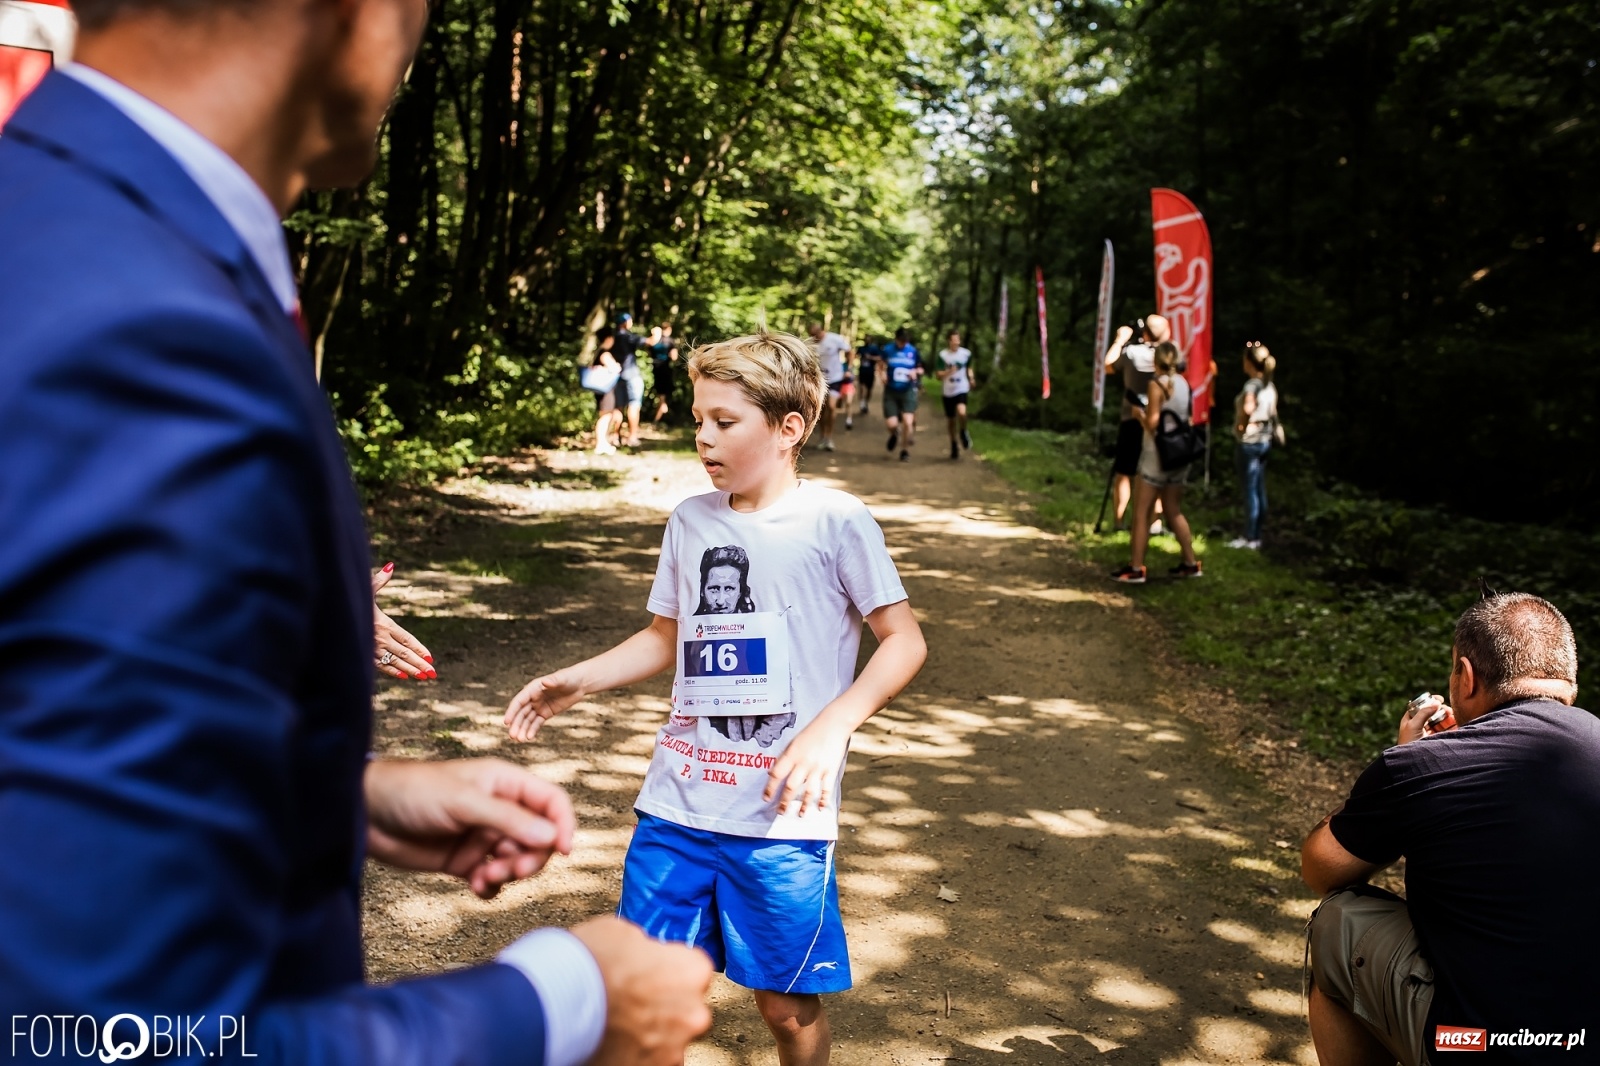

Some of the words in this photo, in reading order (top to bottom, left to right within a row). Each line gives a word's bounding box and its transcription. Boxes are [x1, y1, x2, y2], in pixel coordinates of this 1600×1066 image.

[699, 643, 739, 672] 16
[660, 735, 694, 758] DANUTA
[702, 769, 737, 785] INKA
